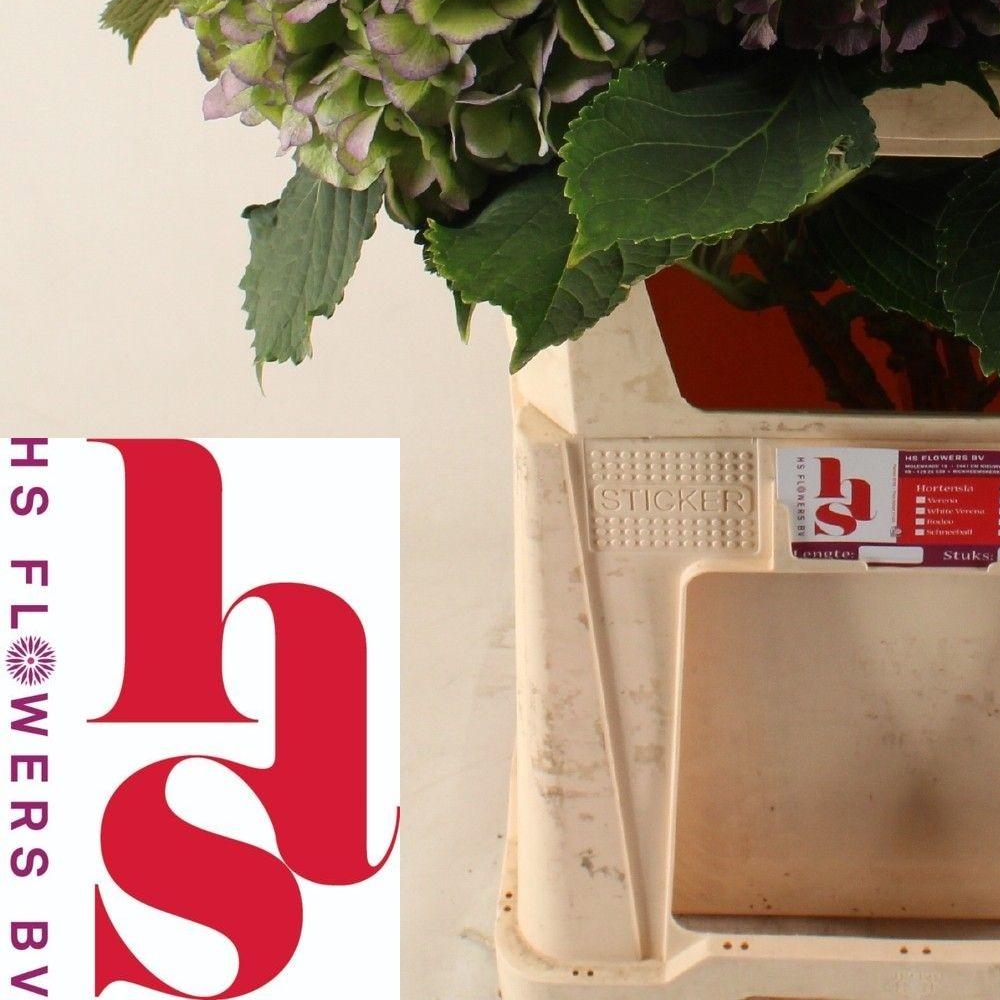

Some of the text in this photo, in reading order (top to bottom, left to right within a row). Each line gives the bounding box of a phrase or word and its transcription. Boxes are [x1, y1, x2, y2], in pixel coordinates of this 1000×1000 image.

[905, 454, 985, 462] HS FLOWERS BV
[916, 484, 974, 494] Hortensia
[600, 488, 745, 513] STICKER
[796, 456, 806, 537] HS FLOWERS BV
[927, 496, 958, 504] Verena
[927, 507, 985, 515] White Verena
[927, 518, 954, 526] Rodeo
[926, 528, 973, 537] Schneeball
[943, 550, 994, 562] Stuks:
